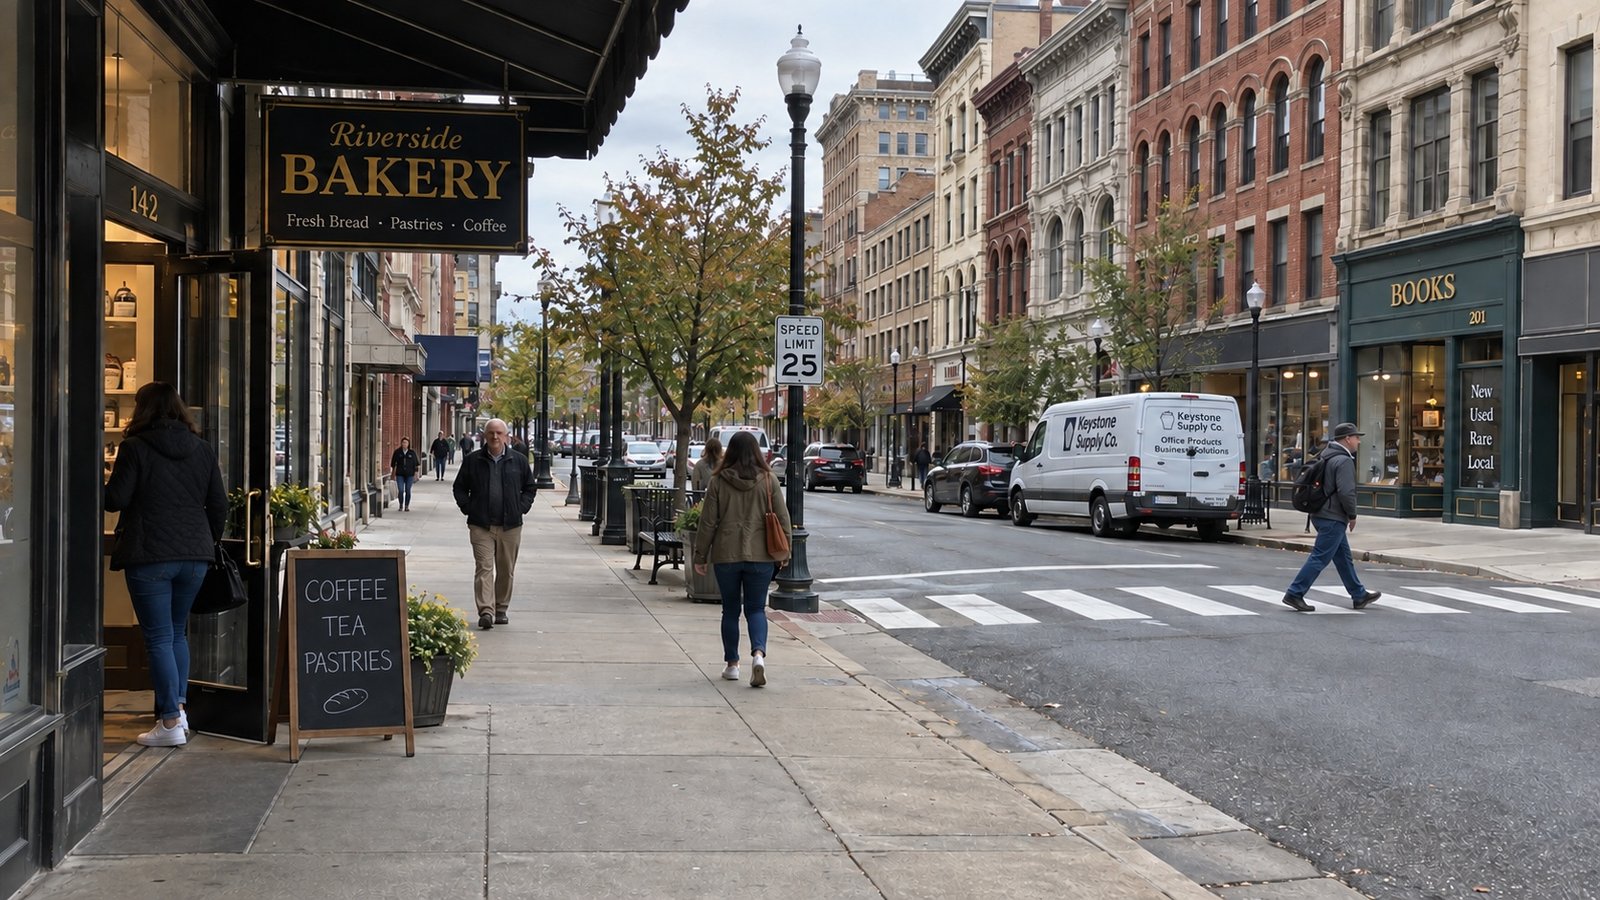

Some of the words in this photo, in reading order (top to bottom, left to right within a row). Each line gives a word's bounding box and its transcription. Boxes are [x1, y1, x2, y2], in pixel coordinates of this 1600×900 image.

[330, 122, 462, 149] Riverside
[281, 154, 510, 199] BAKERY
[130, 185, 158, 222] 142
[286, 213, 325, 228] Fresh
[329, 215, 369, 230] Bread
[390, 216, 443, 232] Pastries
[463, 218, 507, 233] Coffee
[1391, 274, 1456, 307] BOOKS
[1468, 309, 1487, 325] 201
[781, 325, 819, 335] SPEED
[785, 340, 815, 349] LIMIT
[782, 353, 817, 376] 25
[1471, 384, 1493, 399] New
[1177, 412, 1221, 422] Keystone
[1470, 407, 1494, 422] Used
[1078, 416, 1116, 433] Keystone
[1177, 421, 1208, 433] Supply
[1210, 423, 1224, 432] Co.
[1076, 433, 1104, 452] Supply
[1104, 431, 1118, 448] Co.
[1161, 436, 1185, 445] Office
[1187, 437, 1222, 446] Products
[1470, 431, 1493, 446] Rare
[1468, 454, 1495, 470] Local
[305, 578, 387, 602] COFFEE
[322, 615, 366, 636] TEA
[304, 649, 393, 674] PASTRIES
